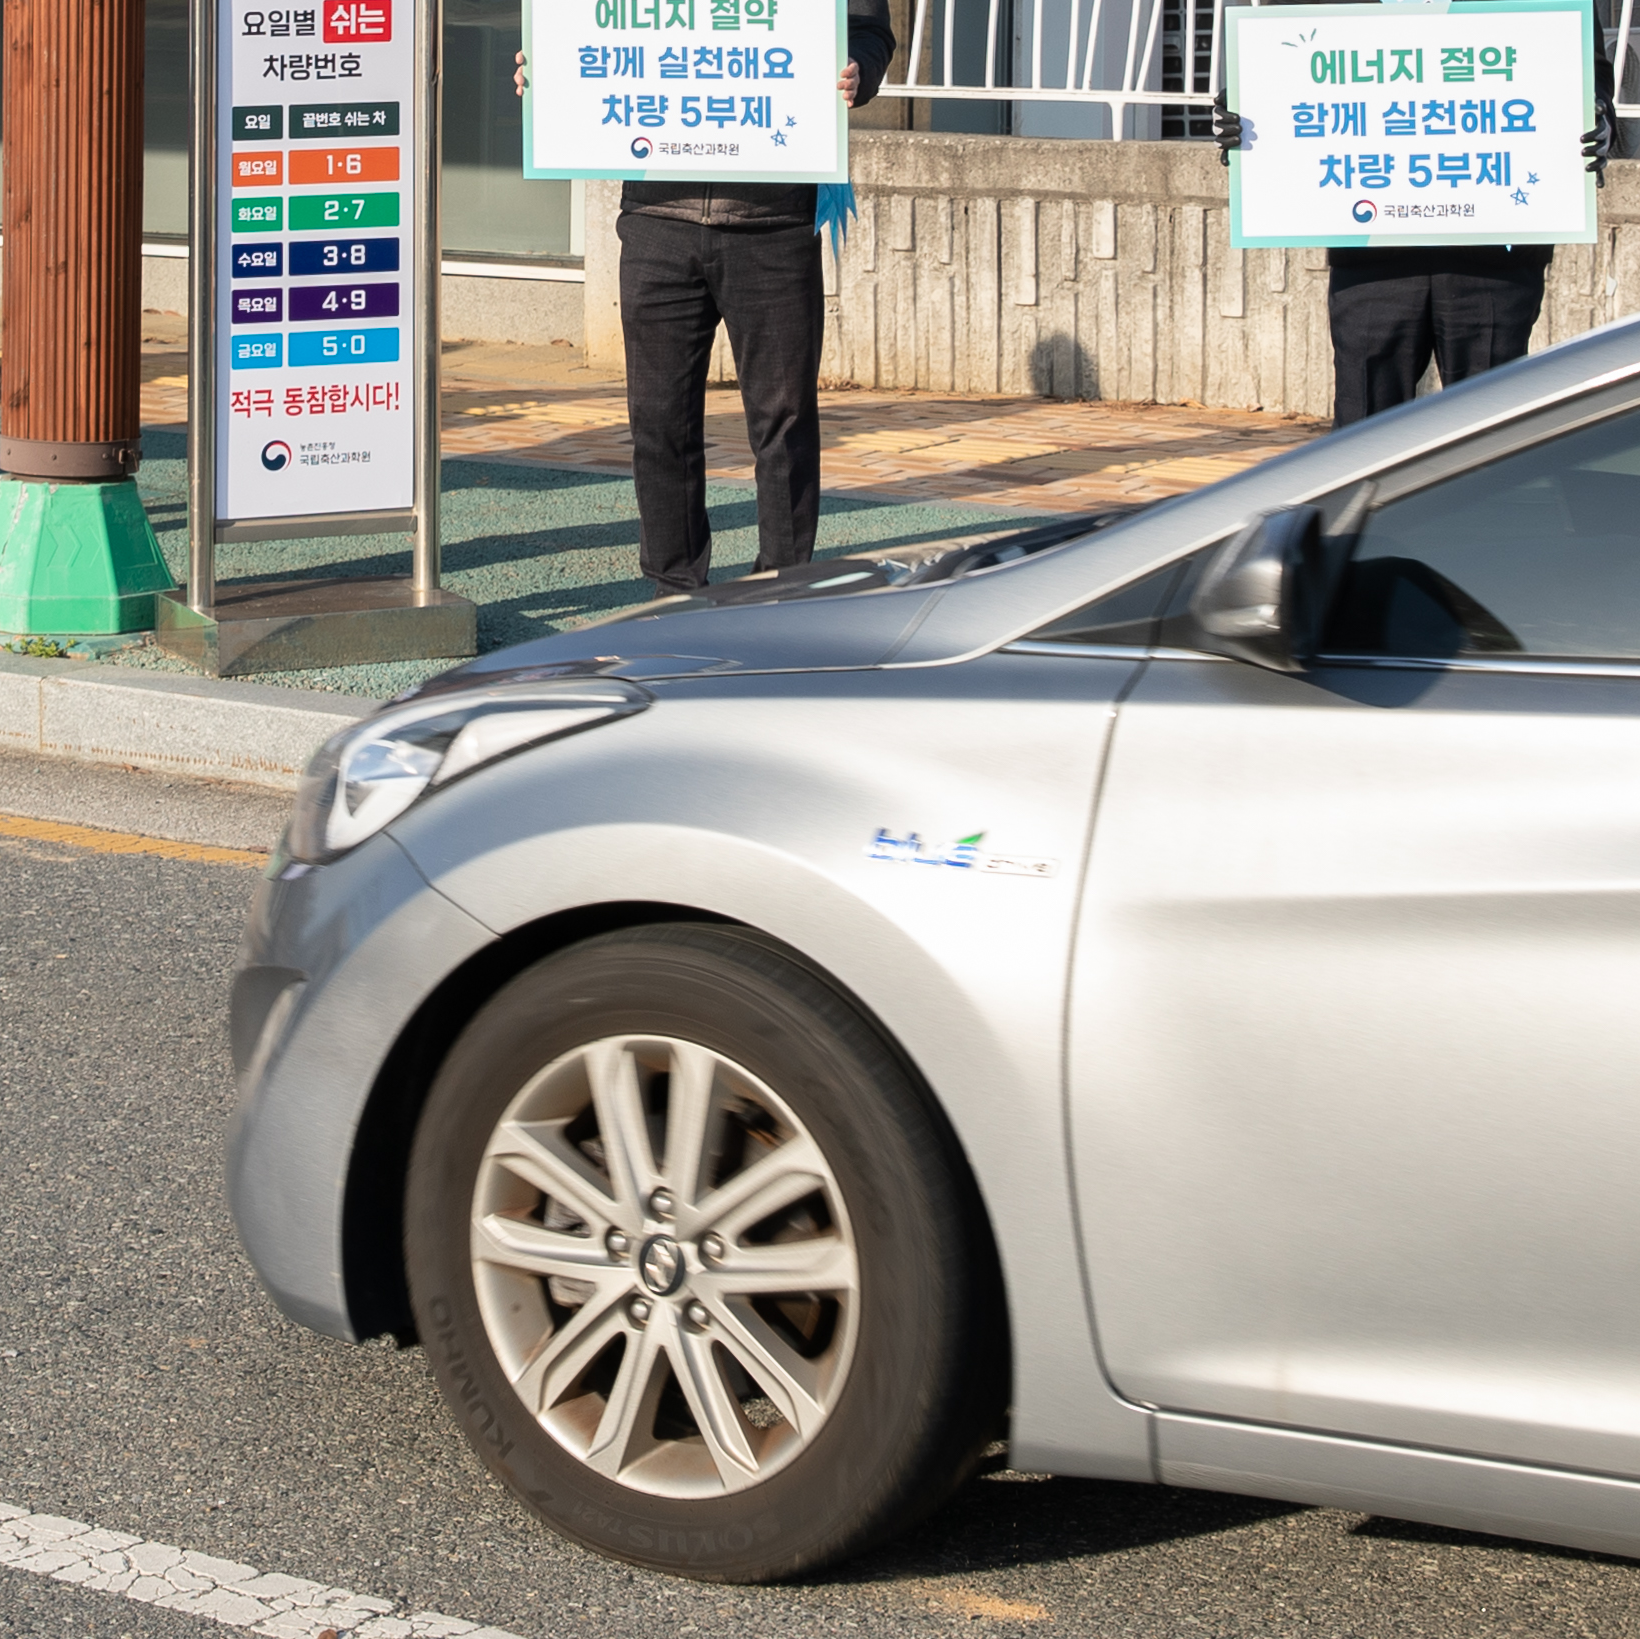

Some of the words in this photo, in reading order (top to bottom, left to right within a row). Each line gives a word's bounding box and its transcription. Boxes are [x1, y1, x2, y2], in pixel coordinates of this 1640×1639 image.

[241, 9, 316, 37] 요일별
[329, 4, 386, 36] 쉬는
[262, 52, 363, 81] 차량번호
[578, 45, 645, 78] 함께
[658, 46, 795, 79] 실천해요
[1310, 48, 1424, 84] 에너지
[1440, 46, 1517, 82] 절약
[344, 111, 370, 126] 쉬는
[372, 110, 386, 125] 차
[601, 94, 669, 127] 차량
[680, 95, 772, 128] 5부제
[1291, 102, 1367, 138] 함께
[1382, 99, 1537, 136] 실천해요
[244, 114, 271, 129] 요일
[658, 142, 740, 156] 국립축산과학원
[238, 160, 277, 176] 월요일
[1318, 153, 1394, 189] 차량
[1408, 151, 1511, 188] 5부제
[238, 206, 277, 221] 화요일
[1383, 203, 1475, 218] 국립축산과학원
[237, 251, 277, 267] 수요일
[237, 297, 277, 313] 목요일
[237, 342, 277, 358] 금요일
[231, 389, 275, 418] 적극
[283, 382, 400, 417] 동참합시다!
[299, 451, 371, 466] 국립축산과학원
